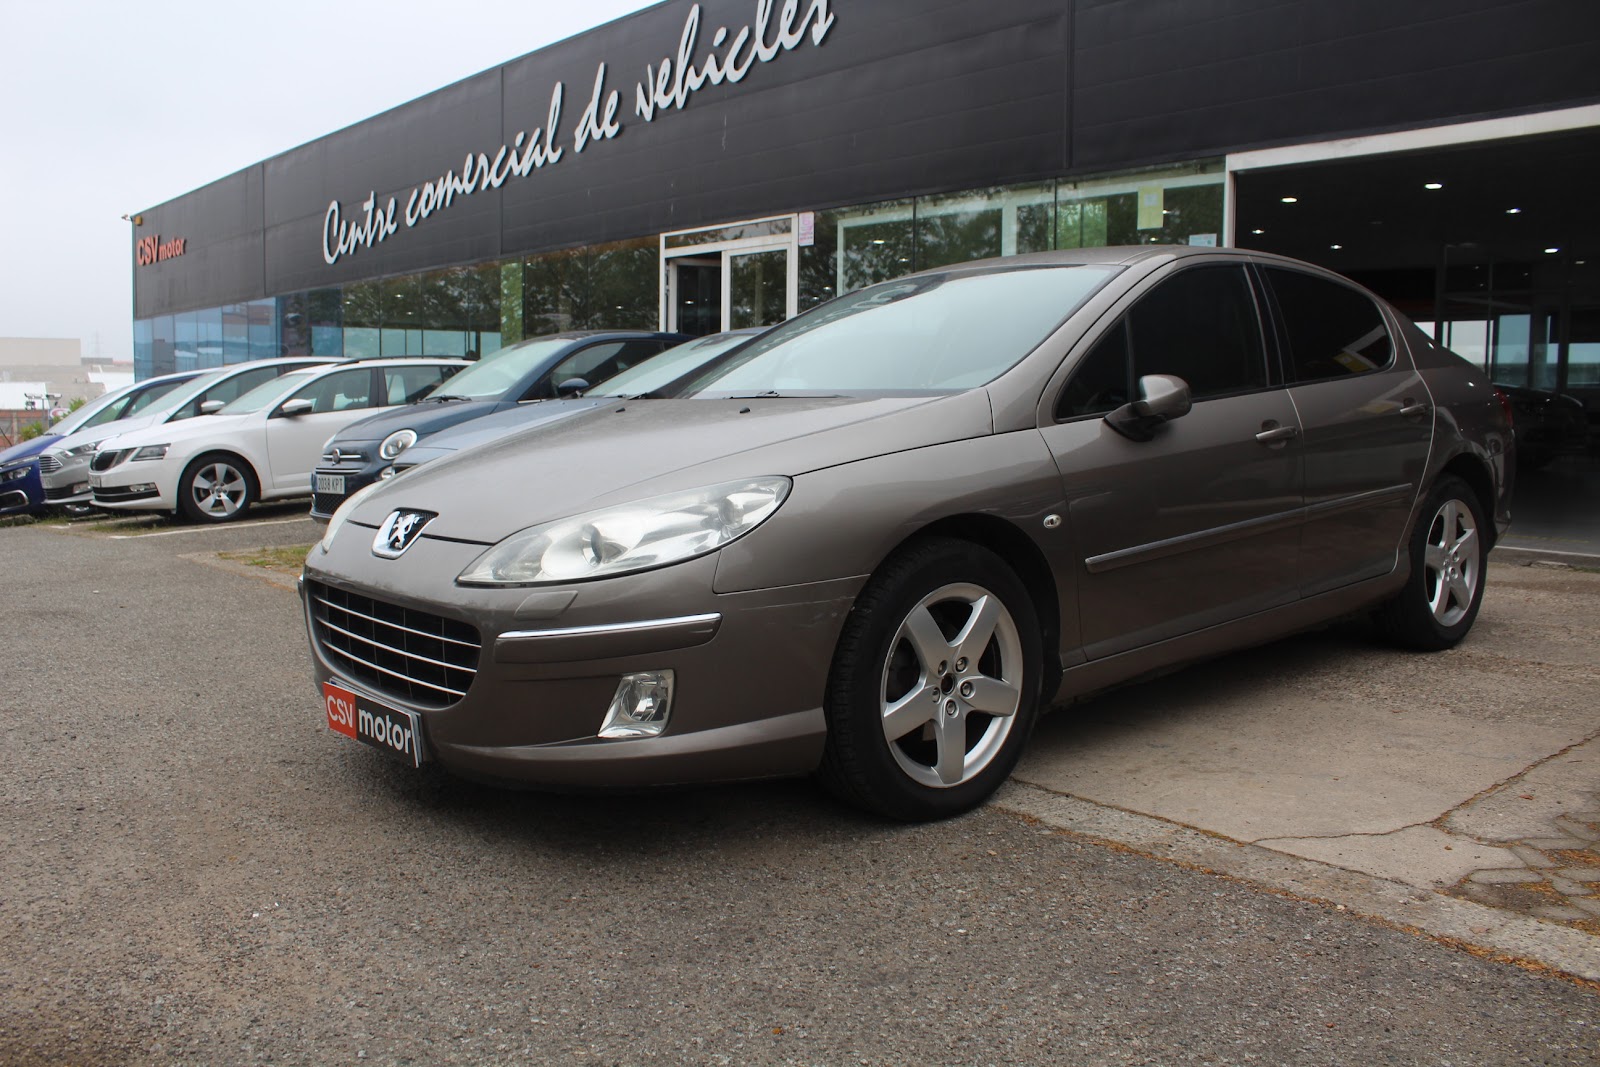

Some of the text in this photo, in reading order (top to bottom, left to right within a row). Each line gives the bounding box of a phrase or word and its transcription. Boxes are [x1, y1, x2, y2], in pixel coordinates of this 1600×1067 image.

[322, 0, 835, 265] Centre comercial de vehicles
[137, 235, 186, 266] CSV motor
[327, 695, 411, 754] CSV motor
